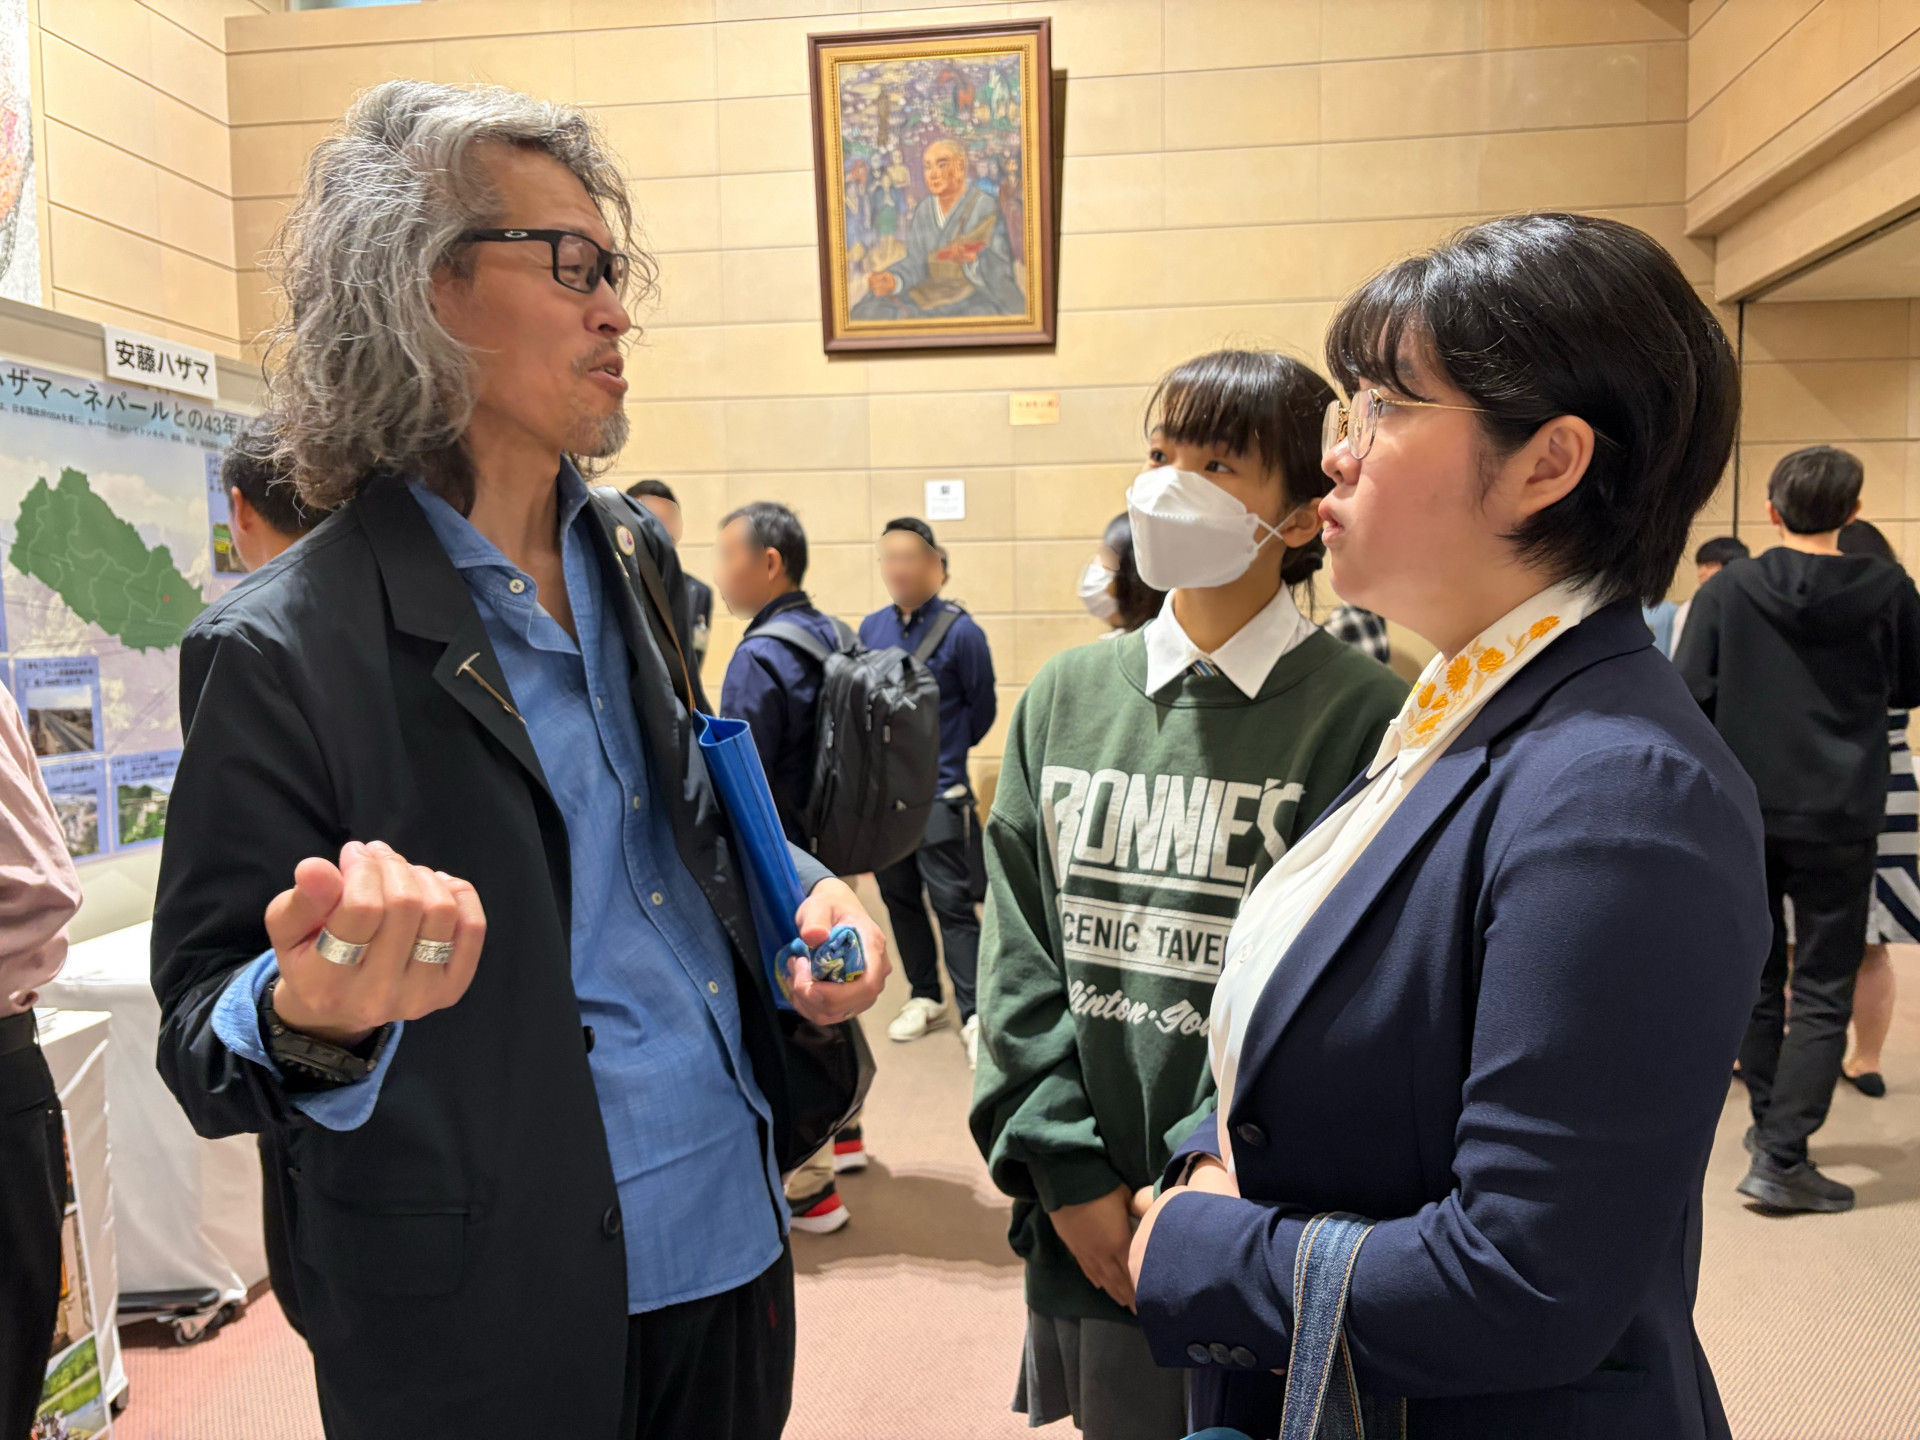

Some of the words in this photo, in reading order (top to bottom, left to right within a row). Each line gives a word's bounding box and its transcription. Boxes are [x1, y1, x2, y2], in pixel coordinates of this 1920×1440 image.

[115, 339, 209, 385] 安藤ハザマ
[0, 367, 245, 438] ザマ〜ネパールとの43年
[1063, 911, 1139, 953] CENIC
[1156, 925, 1229, 966] TAVE
